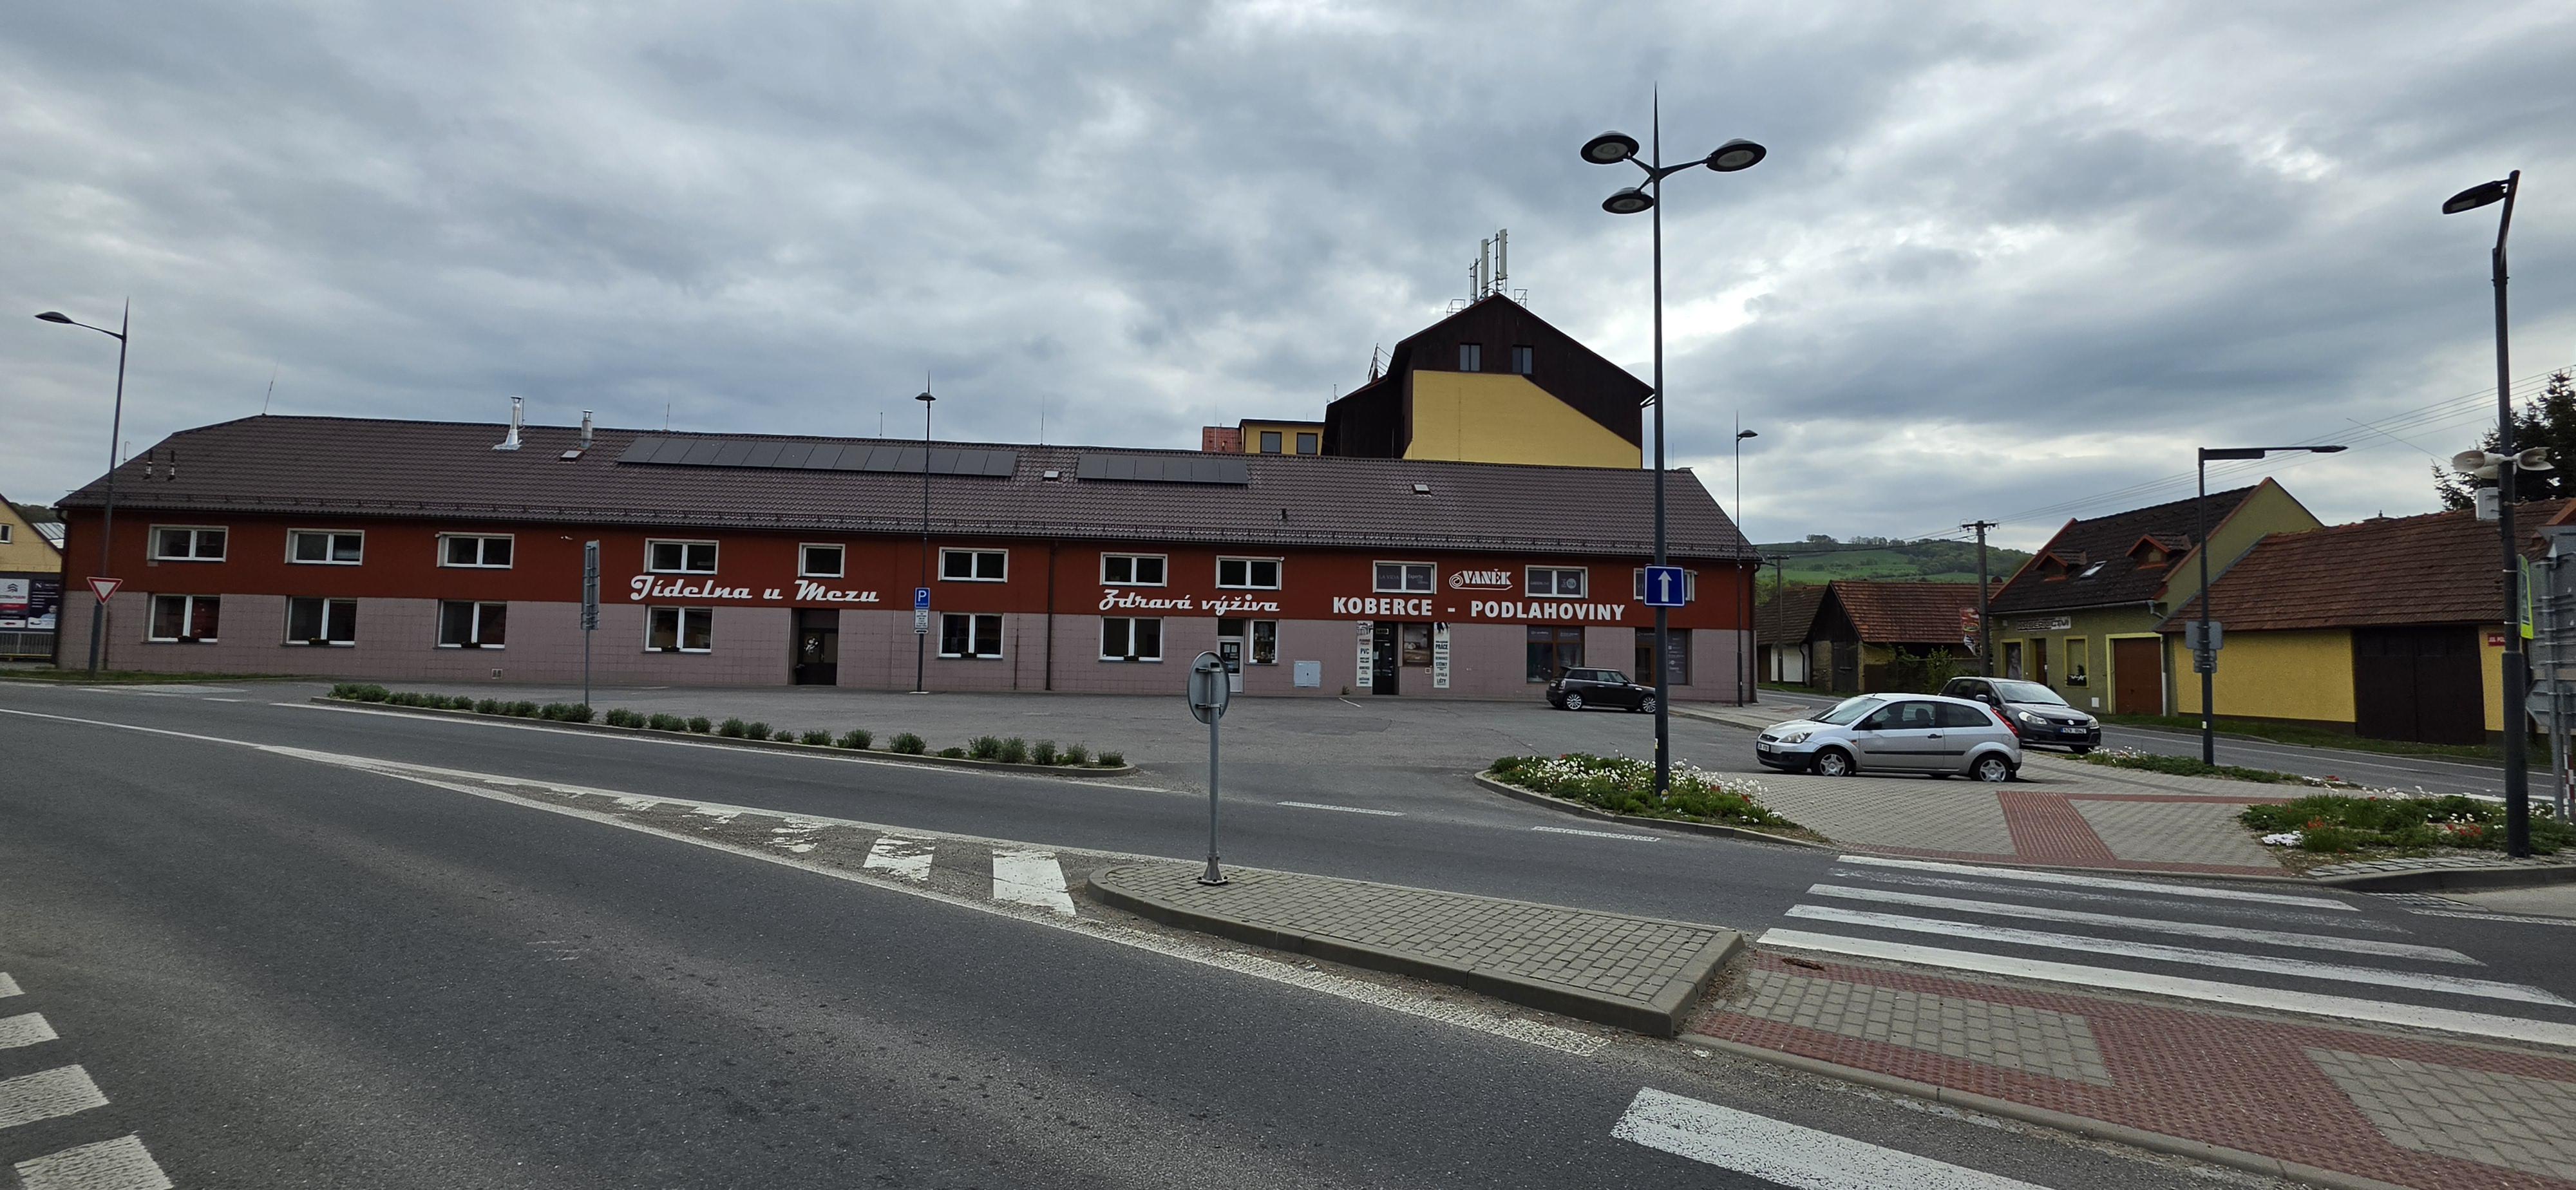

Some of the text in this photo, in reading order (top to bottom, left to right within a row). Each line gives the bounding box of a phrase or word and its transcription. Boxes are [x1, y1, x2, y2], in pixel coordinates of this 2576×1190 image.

[630, 575, 880, 602] Jídelna u Mezu
[1462, 568, 1512, 585] VANĚK
[918, 590, 927, 602] P
[1099, 589, 1280, 616] Zdravá výživa
[1333, 596, 1432, 616] KOBERCE
[1471, 600, 1625, 621] PODLAHOVINY
